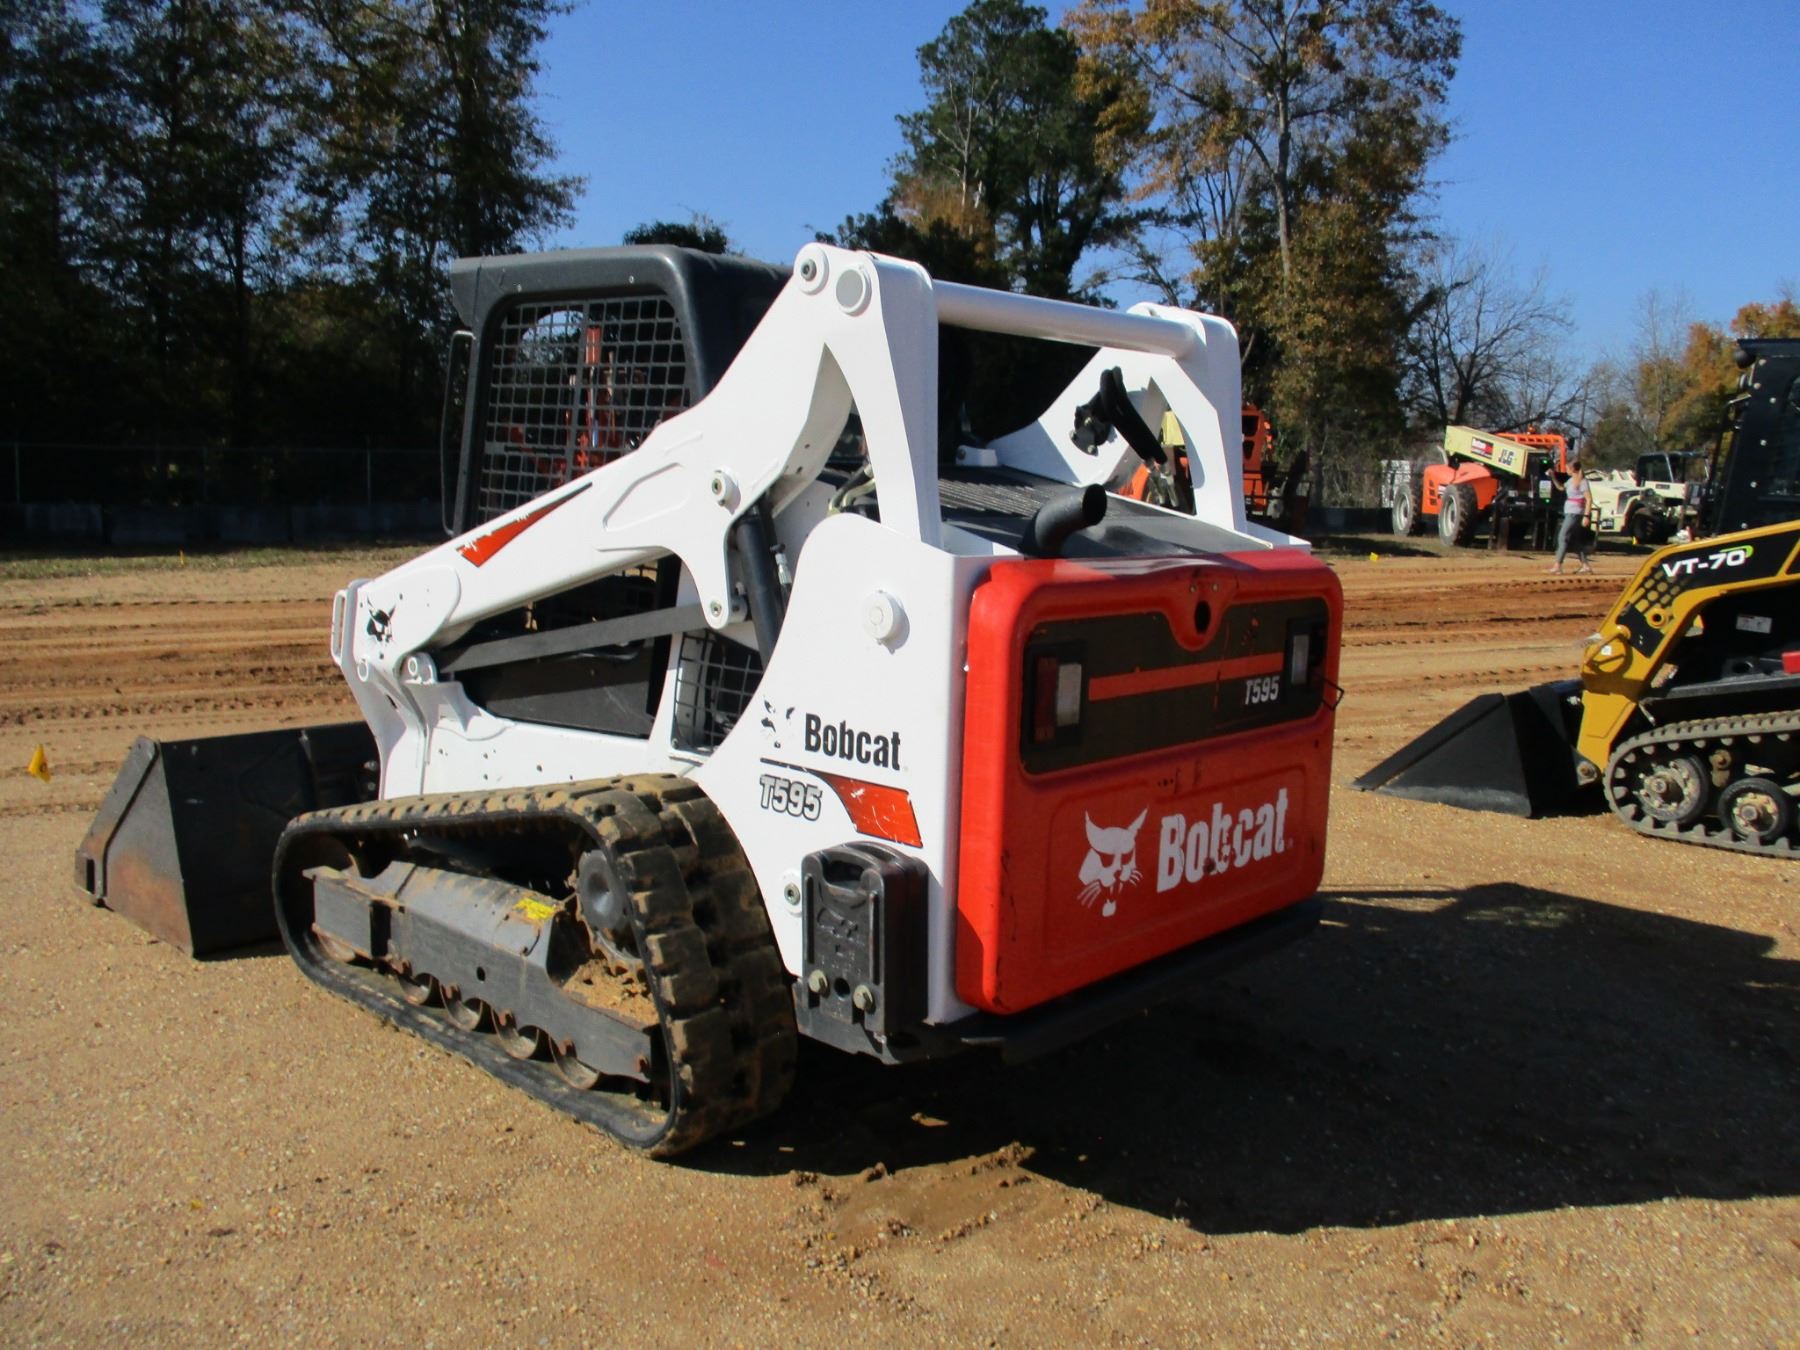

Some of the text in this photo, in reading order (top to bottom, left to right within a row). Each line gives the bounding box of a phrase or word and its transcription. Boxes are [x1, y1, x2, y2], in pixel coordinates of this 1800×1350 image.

[1662, 549, 1746, 578] VT-70
[1244, 675, 1281, 705] T595
[804, 712, 902, 771] Bobcat
[759, 773, 823, 822] T595
[1156, 787, 1289, 893] Bobcat
